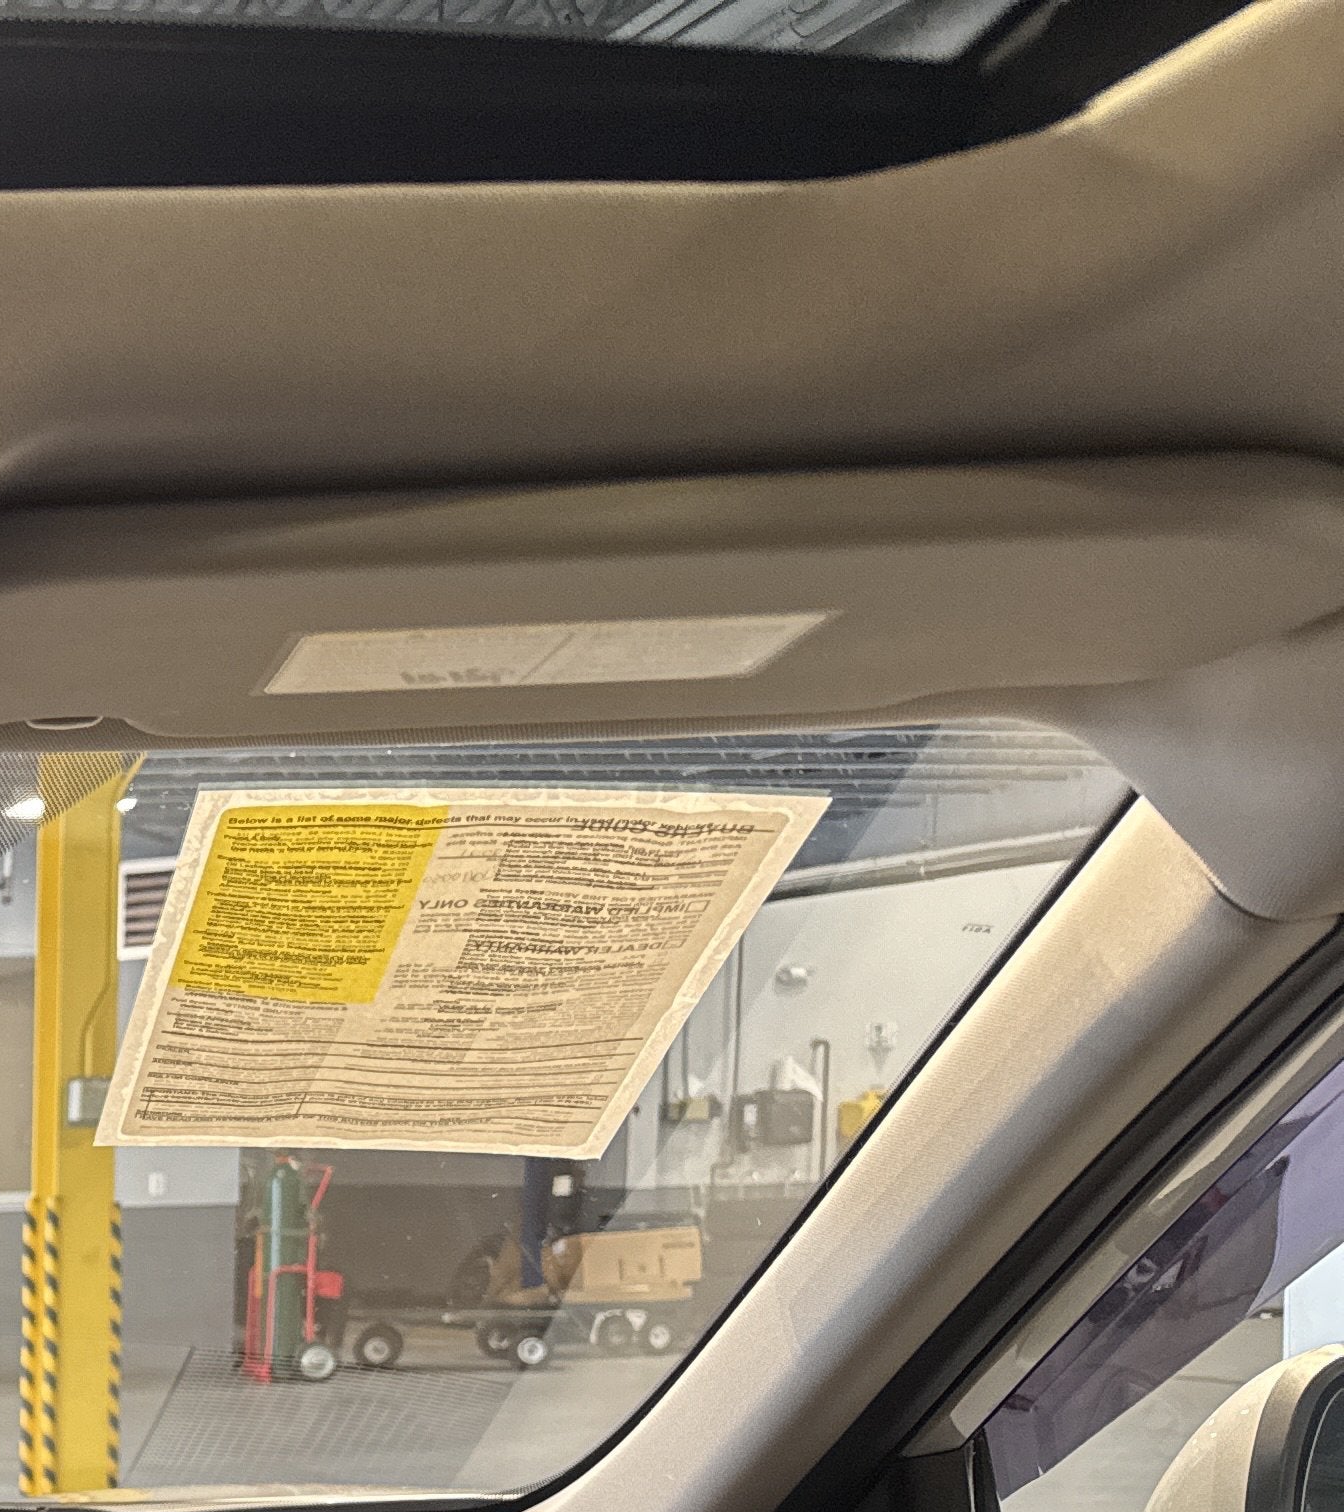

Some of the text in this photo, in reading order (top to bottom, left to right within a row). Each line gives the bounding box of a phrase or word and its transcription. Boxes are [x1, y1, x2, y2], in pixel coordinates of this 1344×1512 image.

[228, 816, 268, 825] Below
[296, 814, 317, 824] list
[335, 814, 372, 824] some
[465, 813, 492, 823] that
[493, 815, 523, 825] may
